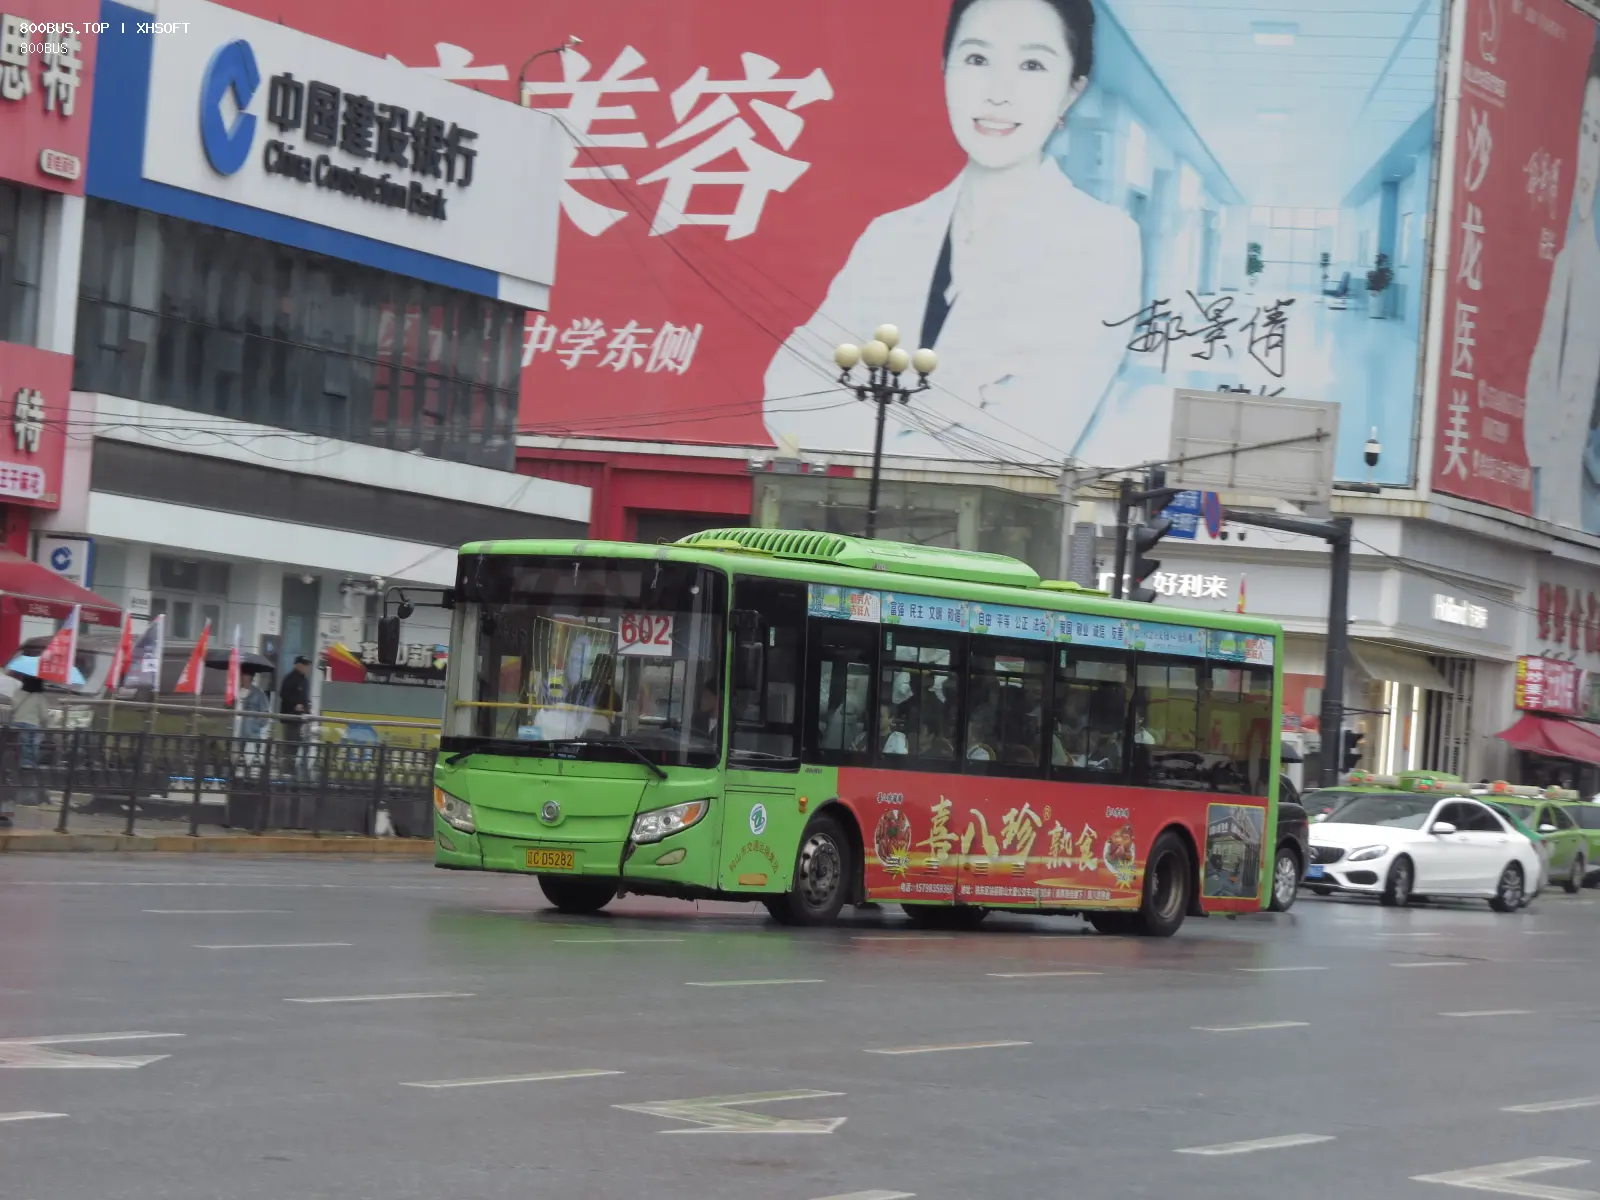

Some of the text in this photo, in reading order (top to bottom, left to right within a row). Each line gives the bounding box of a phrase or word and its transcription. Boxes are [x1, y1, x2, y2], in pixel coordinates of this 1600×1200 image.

[267, 71, 479, 187] 中国建设银行
[1152, 571, 1229, 598] 好利来
[909, 603, 924, 619] 民主
[928, 606, 943, 621] 文明
[978, 612, 992, 627] 自由
[996, 613, 1010, 629] 平等
[1015, 616, 1029, 631] 公正
[620, 612, 671, 646] 602
[916, 795, 1098, 871] 喜八珍 熟食
